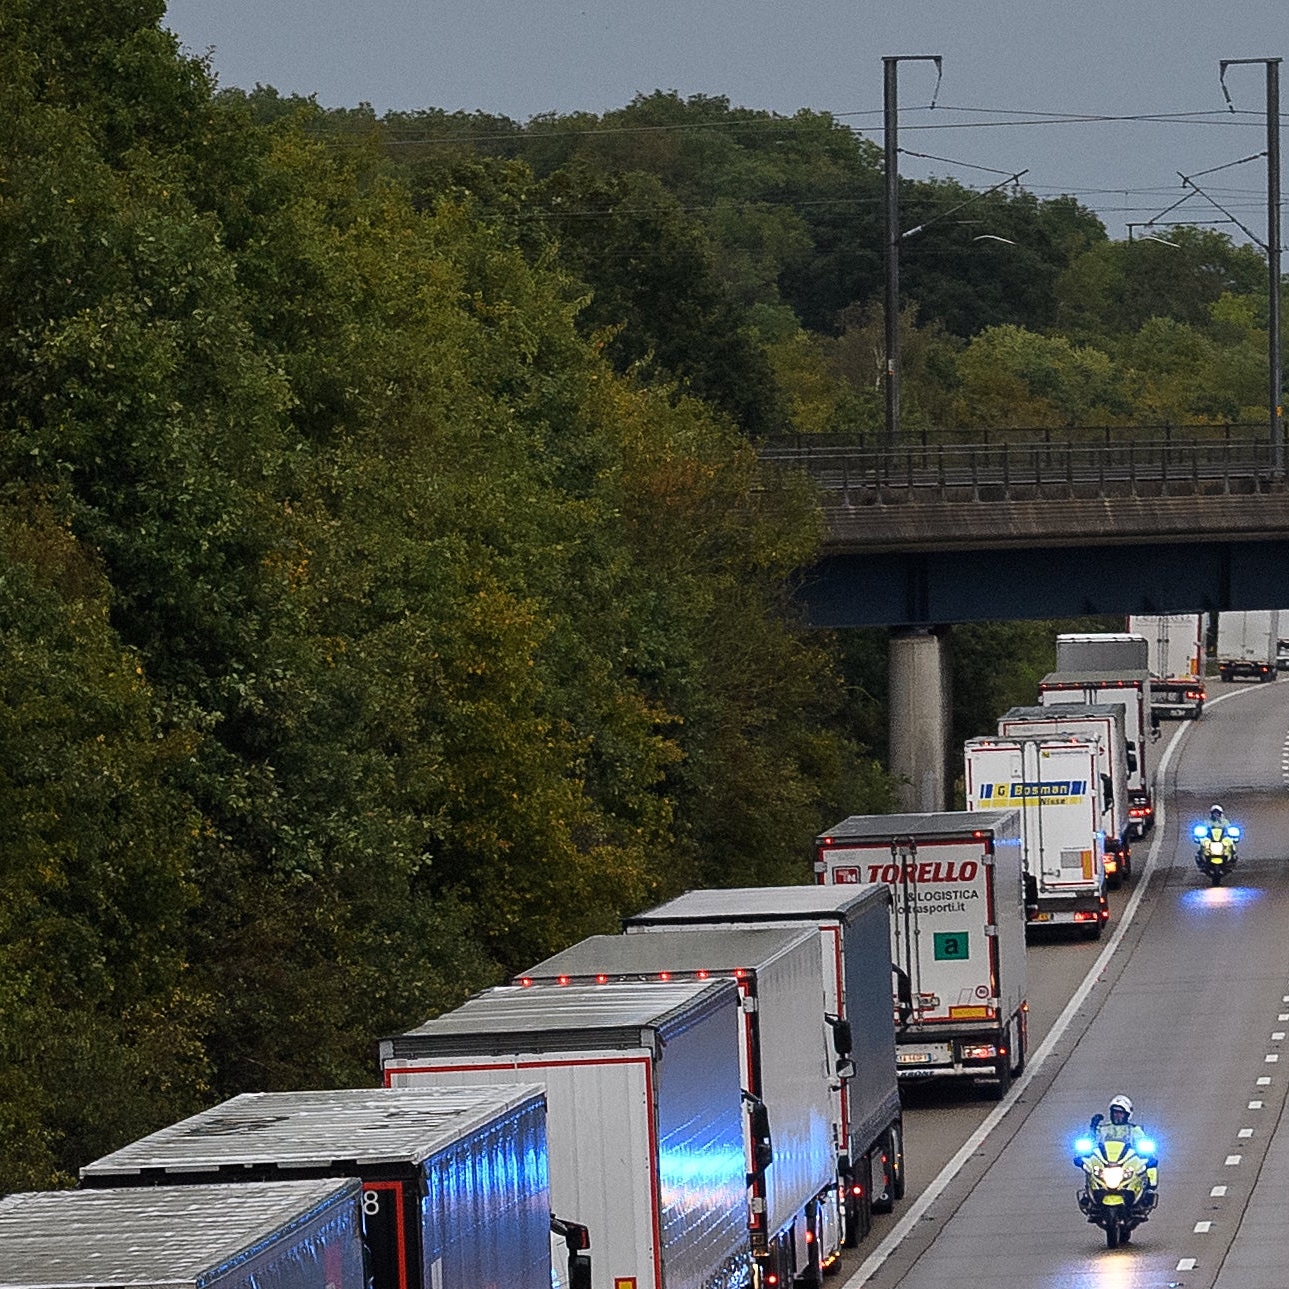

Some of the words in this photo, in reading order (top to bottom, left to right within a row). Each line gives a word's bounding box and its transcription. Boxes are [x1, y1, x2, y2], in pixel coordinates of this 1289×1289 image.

[1014, 785, 1069, 796] Bosman
[867, 861, 978, 884] TORELLO
[917, 889, 979, 902] LOGISTICA
